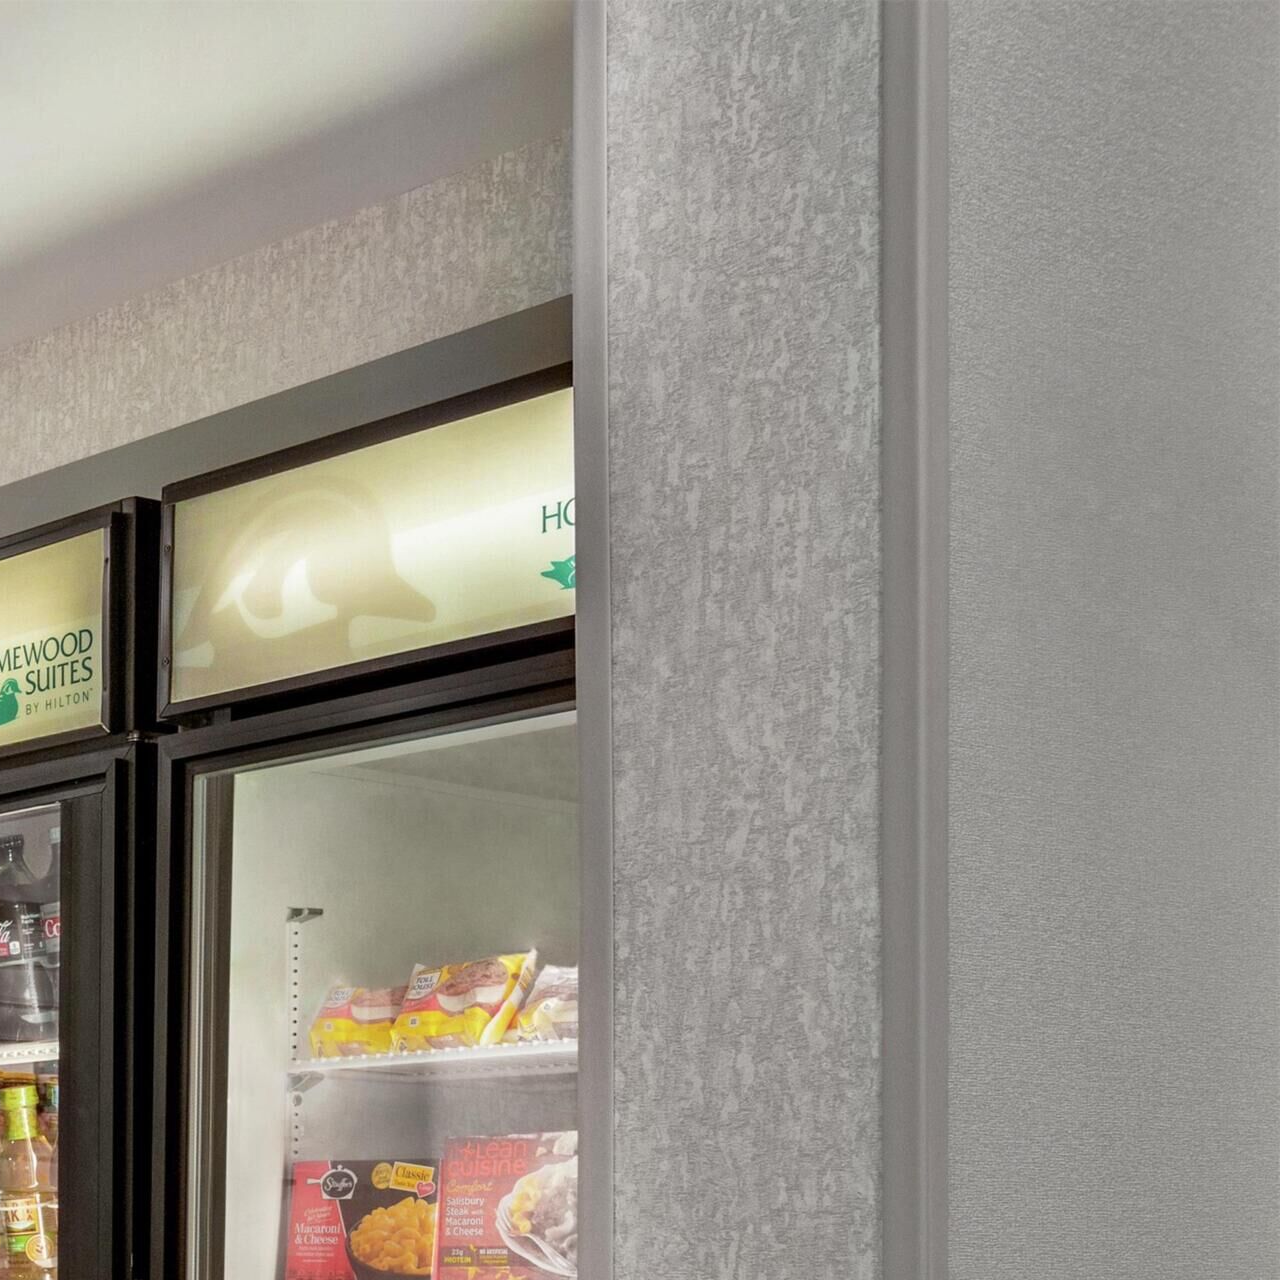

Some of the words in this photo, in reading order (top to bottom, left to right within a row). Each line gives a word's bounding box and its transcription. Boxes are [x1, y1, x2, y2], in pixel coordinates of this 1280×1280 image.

[25, 656, 94, 696] SUITES
[25, 703, 41, 716] BY
[45, 690, 91, 713] HILTON
[395, 1166, 430, 1179] Classic
[446, 1197, 484, 1207] Salisbury
[446, 1206, 468, 1215] Steak
[445, 1217, 484, 1226] Macaroni
[294, 1223, 341, 1234] Macaroni
[445, 1228, 451, 1236] &
[453, 1228, 483, 1236] Cheese
[294, 1236, 303, 1244] &
[304, 1235, 338, 1245] Cheese
[444, 1256, 472, 1264] PROTEIN
